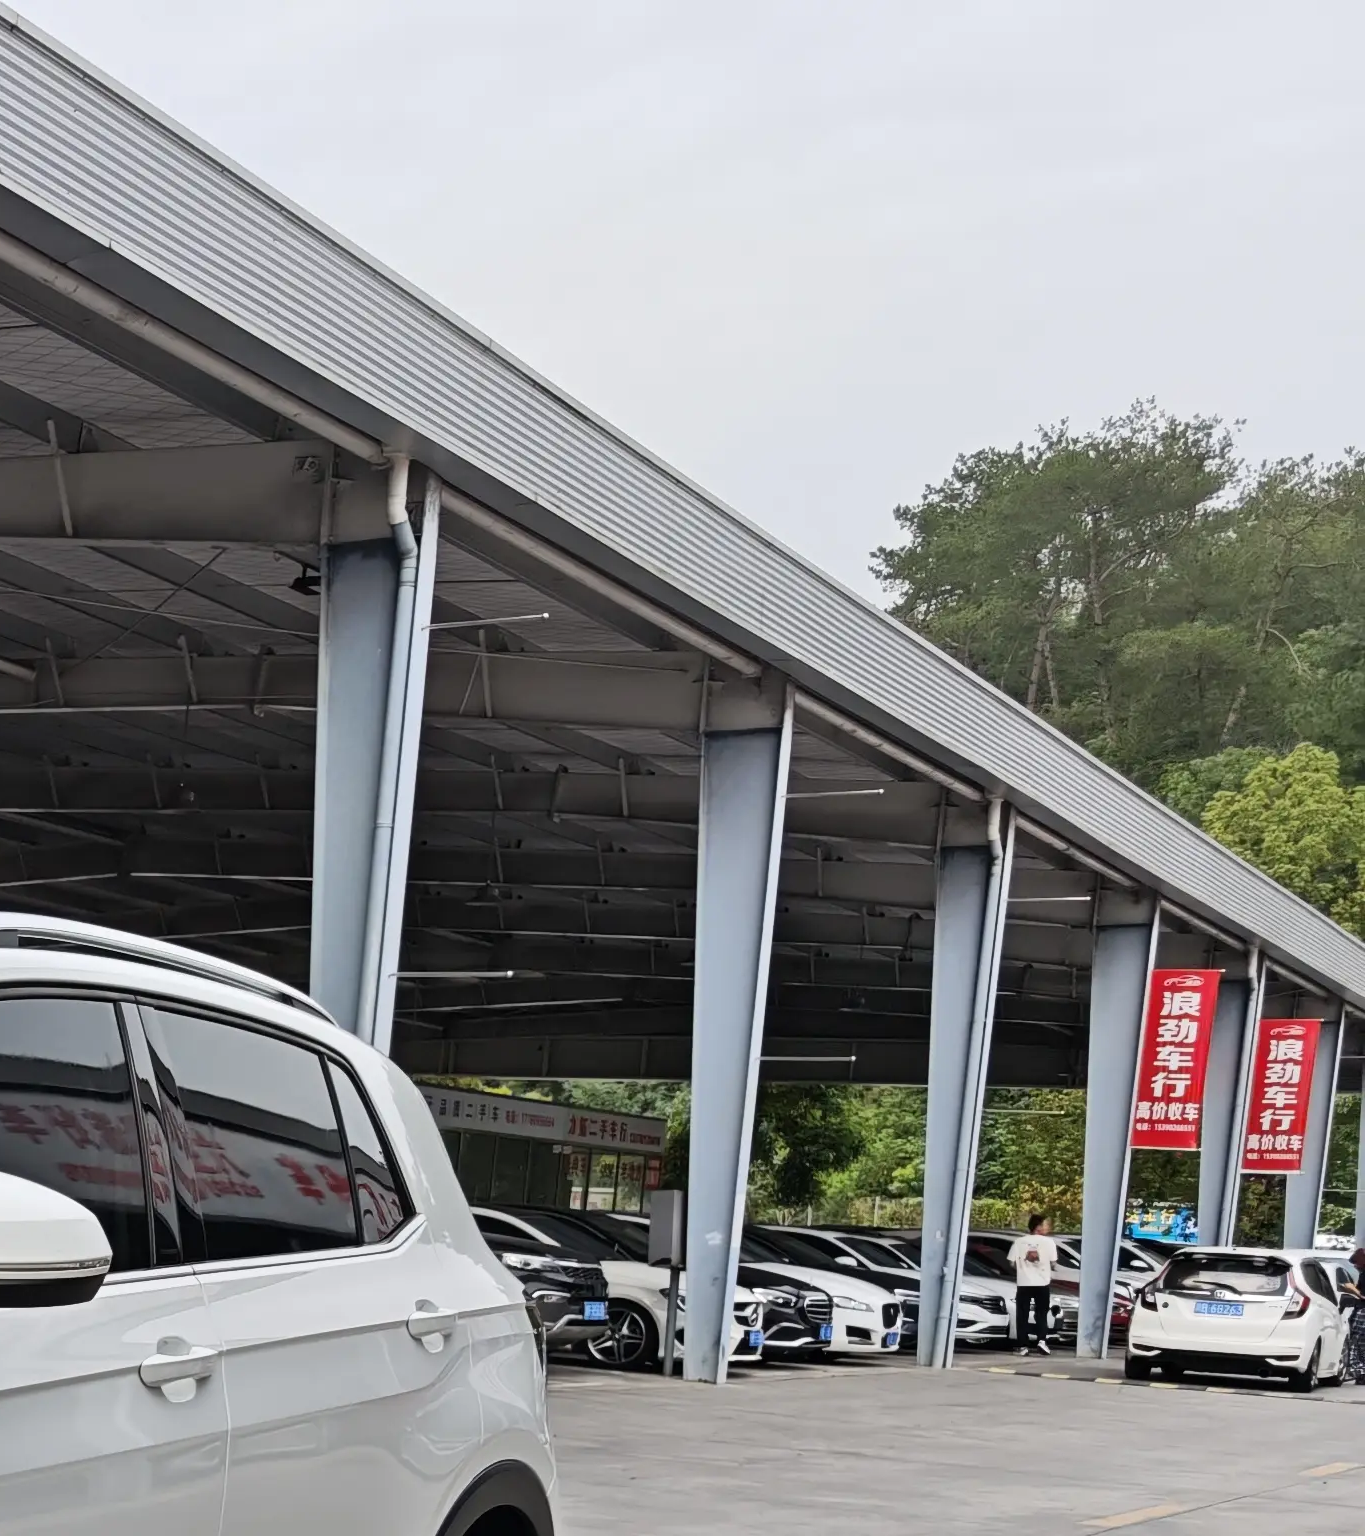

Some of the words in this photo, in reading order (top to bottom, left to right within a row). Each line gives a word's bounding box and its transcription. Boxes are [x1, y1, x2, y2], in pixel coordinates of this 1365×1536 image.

[1150, 991, 1202, 1098] 浪劲车行
[1135, 1101, 1200, 1122] 高价收车
[1259, 1038, 1304, 1131] 浪劲车行
[1246, 1133, 1304, 1150] 高价收车
